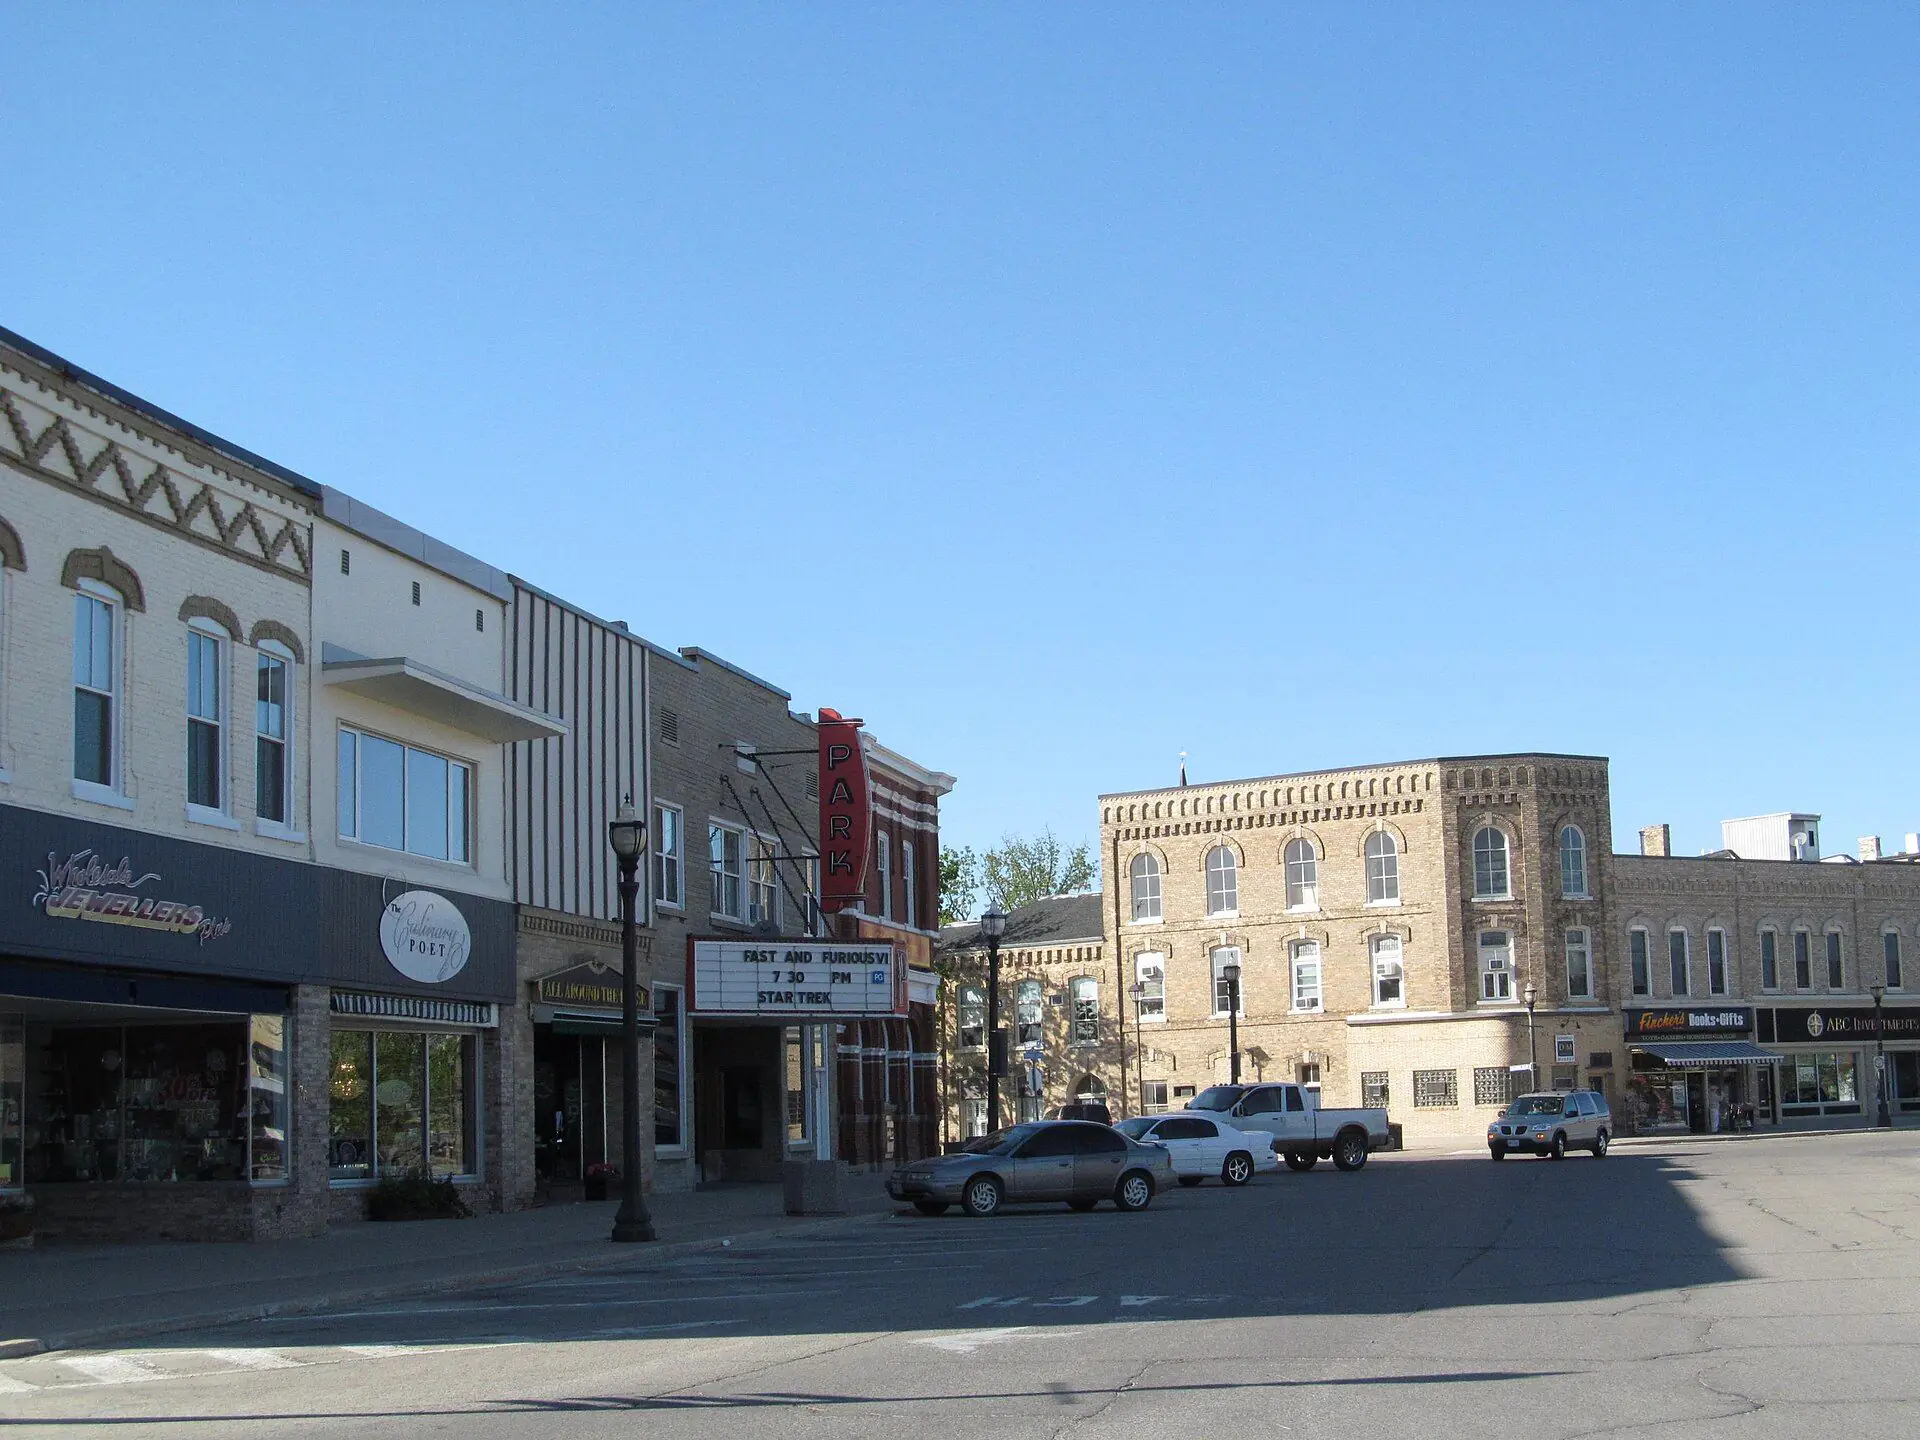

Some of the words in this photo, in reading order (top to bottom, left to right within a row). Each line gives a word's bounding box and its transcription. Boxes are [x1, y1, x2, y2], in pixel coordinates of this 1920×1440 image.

[828, 744, 854, 876] PARK
[49, 849, 161, 888] Wholesale
[46, 886, 204, 934] JEWELLERS
[390, 903, 401, 914] The
[410, 939, 445, 957] POET
[743, 950, 776, 963] FAST
[784, 951, 812, 964] AND
[832, 972, 851, 984] PM
[874, 973, 884, 982] PG
[546, 981, 563, 997] ALL
[564, 982, 600, 1001] AROUND
[757, 991, 794, 1004] STAR
[799, 992, 832, 1005] TREK
[1826, 1016, 1851, 1032] ABC
[1853, 1016, 1920, 1032] INVETMENTS
